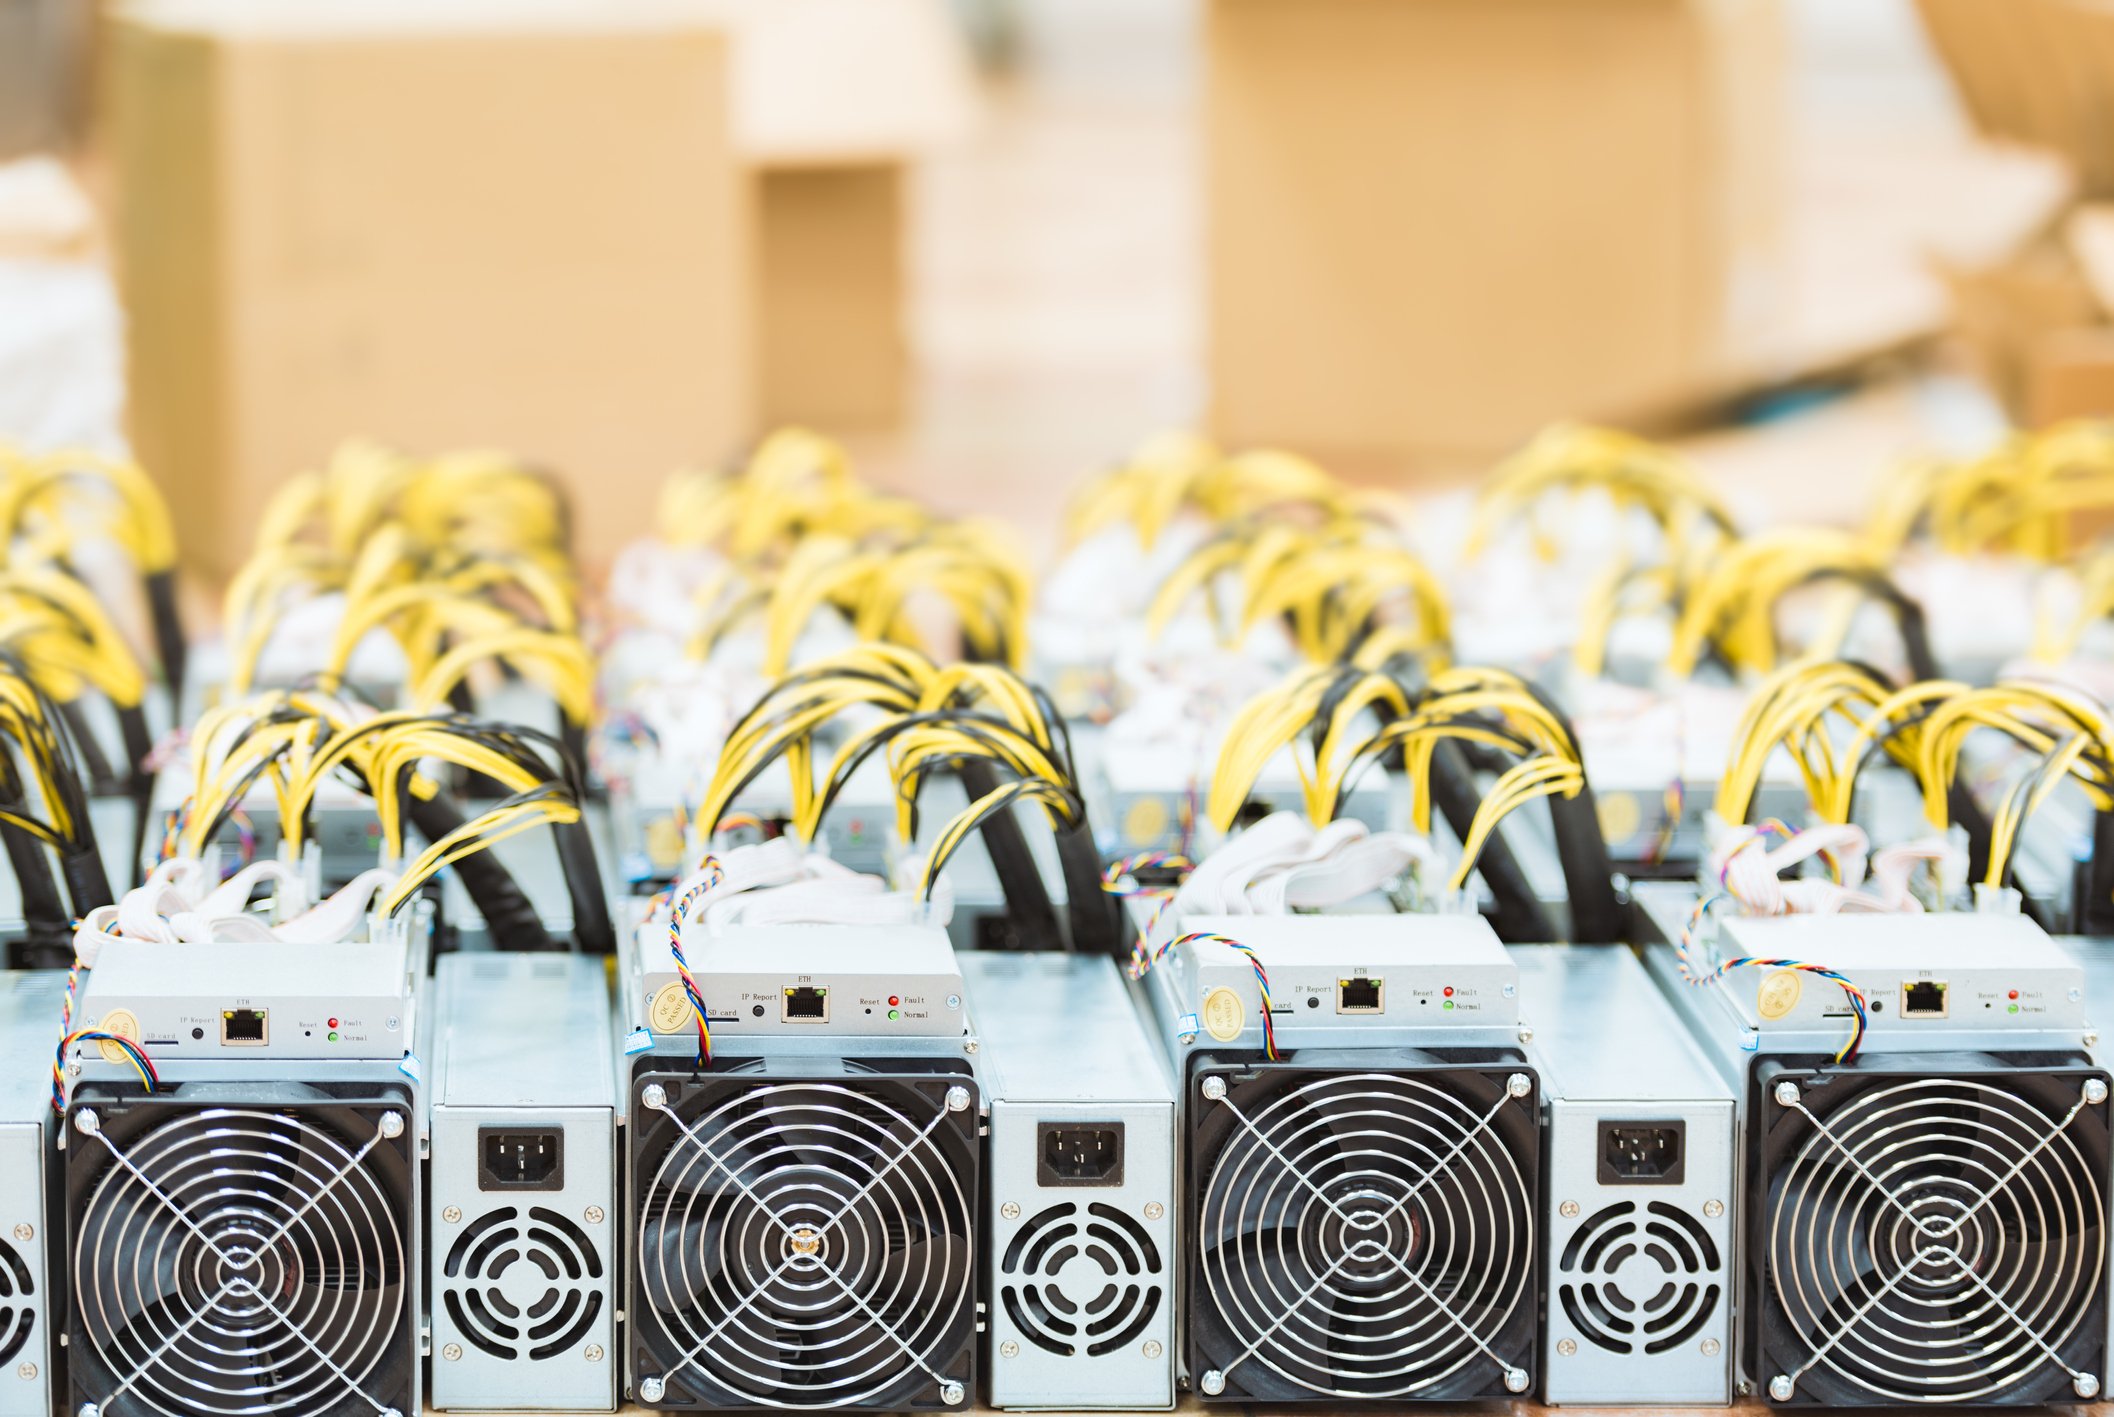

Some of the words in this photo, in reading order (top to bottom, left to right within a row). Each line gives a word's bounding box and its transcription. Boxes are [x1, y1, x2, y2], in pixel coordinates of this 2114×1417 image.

[1306, 985, 1332, 993] Report
[1456, 988, 1477, 996] Fault
[741, 992, 750, 1000] IP
[752, 993, 778, 1001] Report
[859, 997, 880, 1005] Reset
[660, 1004, 670, 1016] QC
[667, 996, 687, 1023] PASSED
[1456, 1002, 1481, 1010] Normal
[903, 1010, 929, 1018] Normal
[1224, 998, 1232, 1027] PASSED
